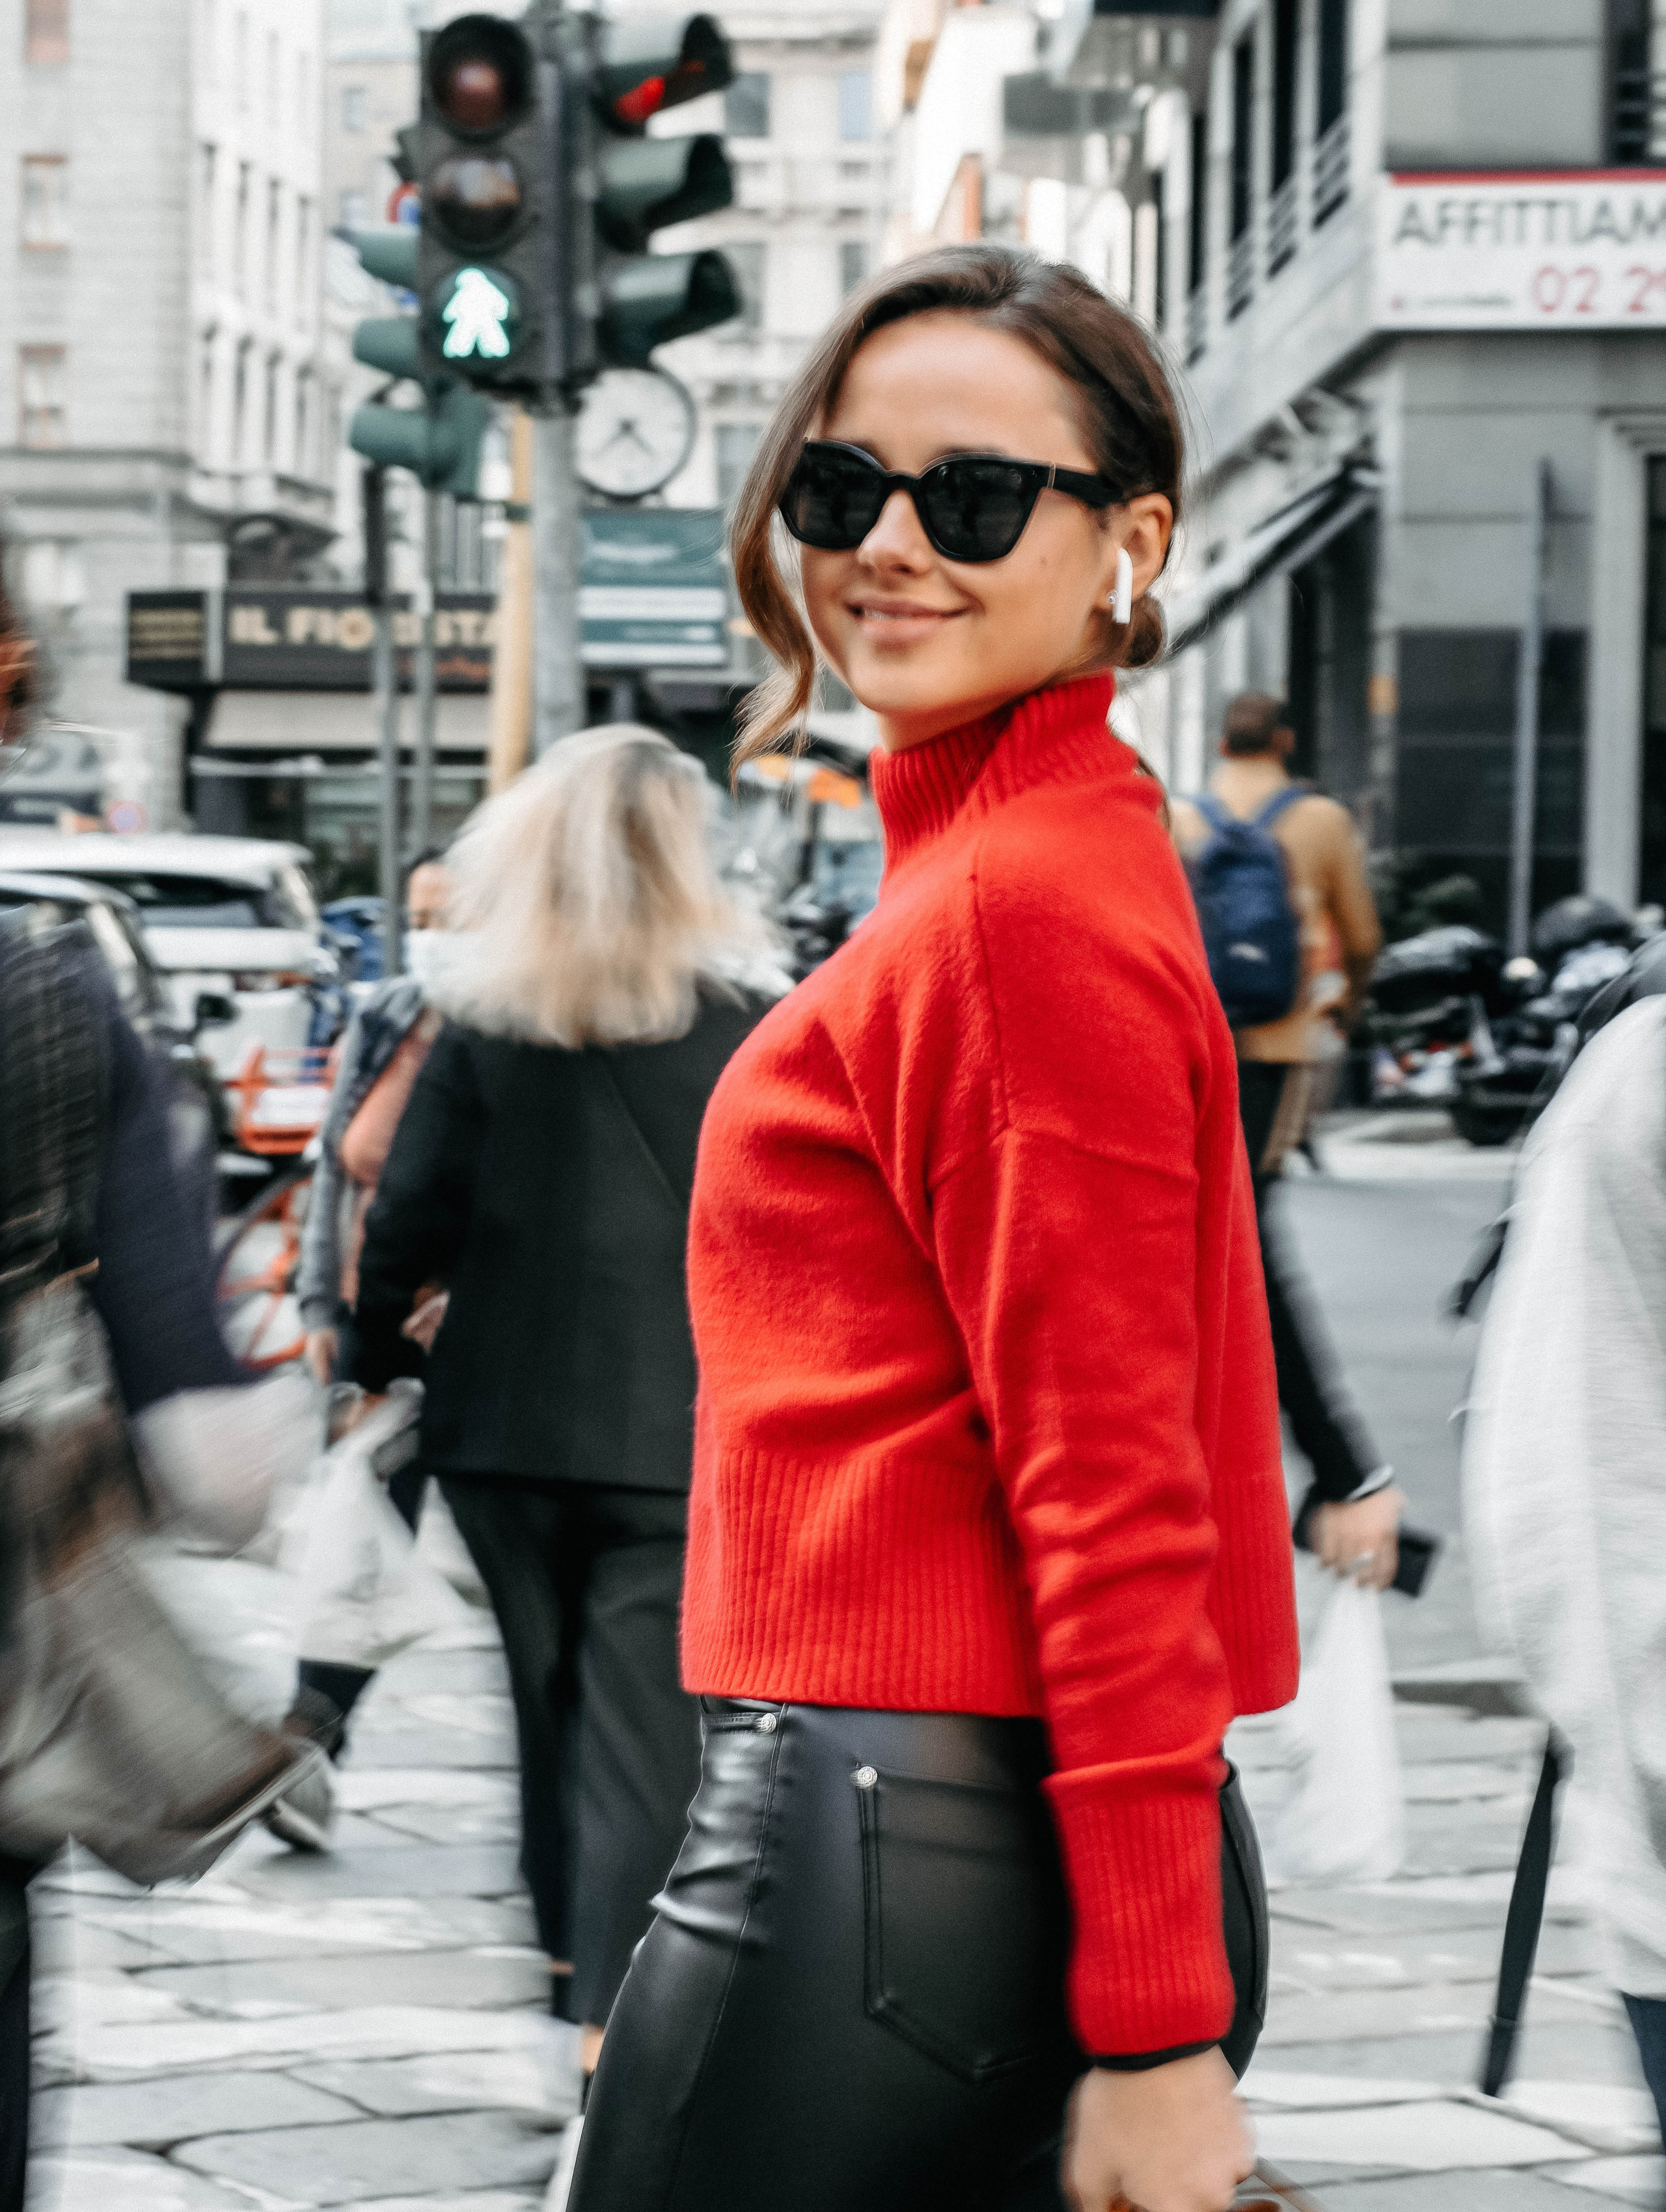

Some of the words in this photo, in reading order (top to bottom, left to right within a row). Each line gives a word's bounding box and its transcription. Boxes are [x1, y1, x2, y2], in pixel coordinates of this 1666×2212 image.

[1392, 198, 1666, 245] AFFITTIAM
[1531, 264, 1601, 312] 02
[229, 605, 277, 645] IL
